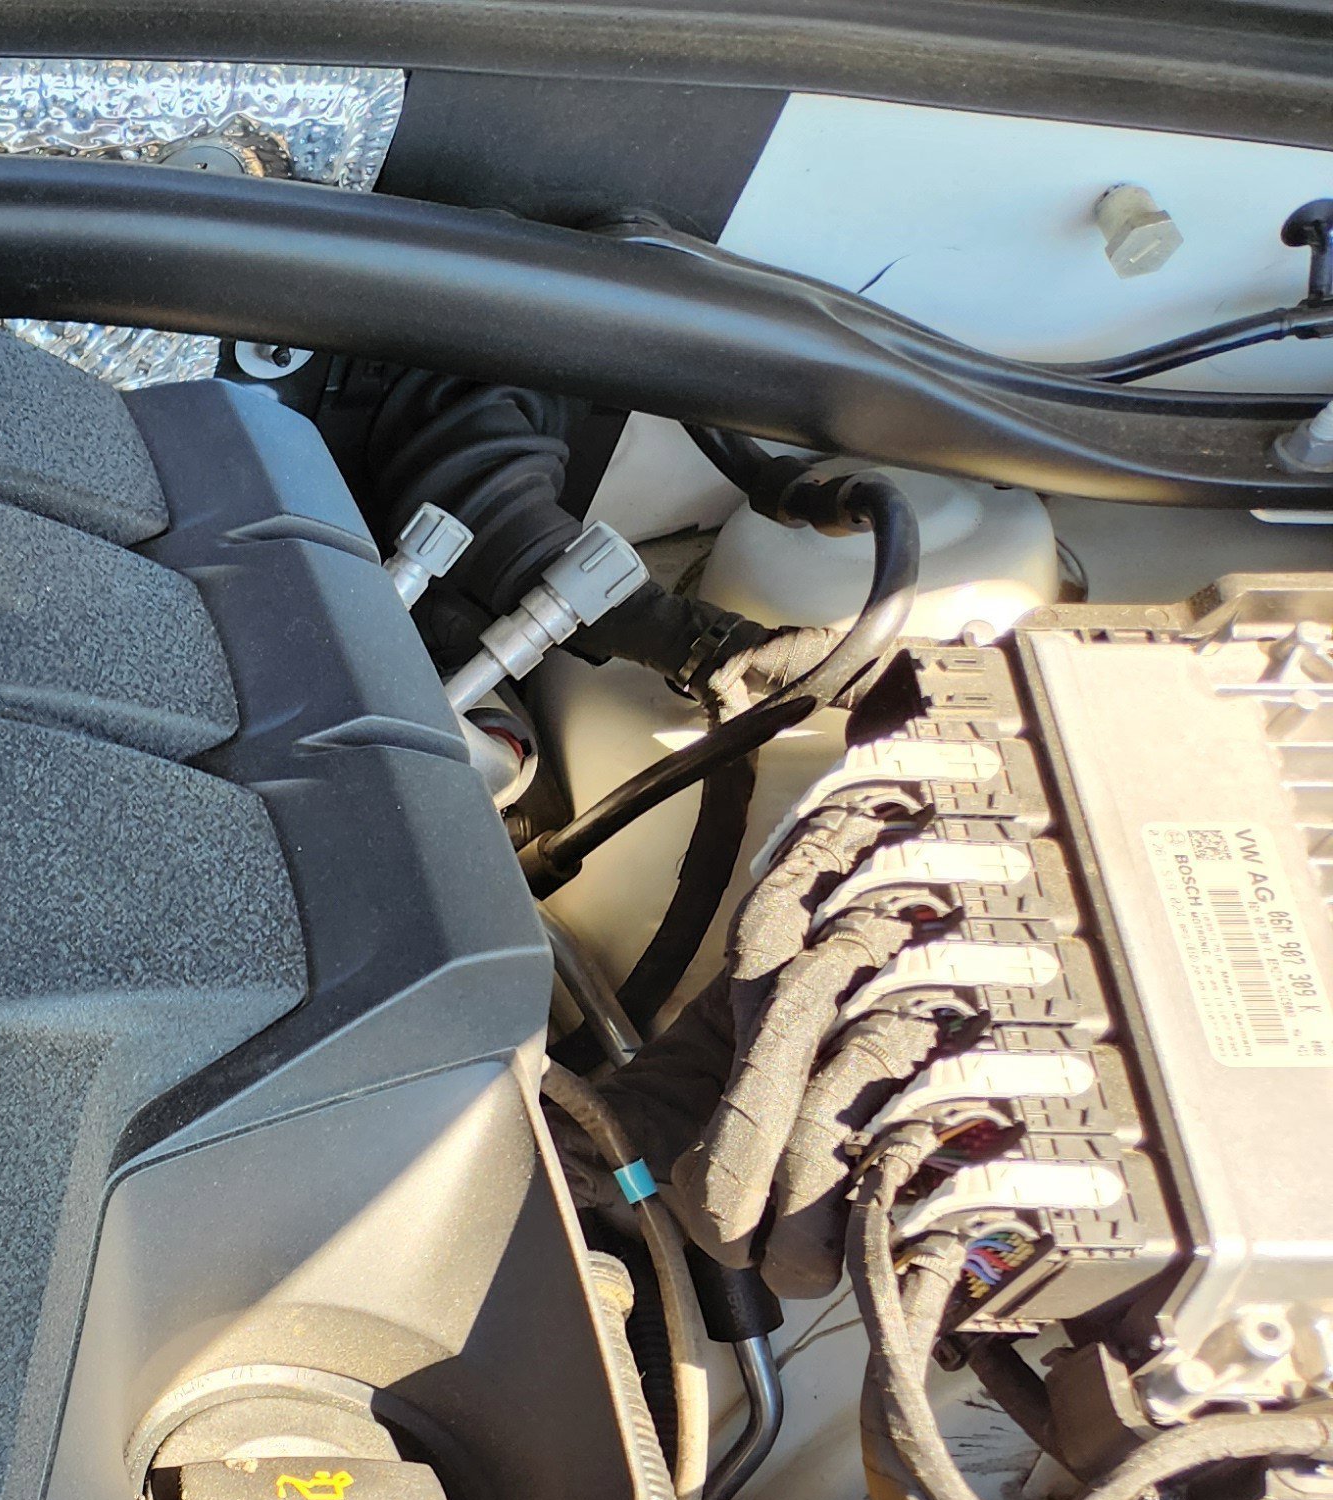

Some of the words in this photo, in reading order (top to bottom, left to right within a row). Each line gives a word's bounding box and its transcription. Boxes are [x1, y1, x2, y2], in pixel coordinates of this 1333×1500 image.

[1233, 828, 1263, 864] VW
[1173, 854, 1203, 906] BOSCH
[1247, 871, 1276, 902] AG
[1266, 911, 1295, 933] 06M
[1276, 942, 1306, 965] 907
[1287, 973, 1317, 996] 309
[1297, 1004, 1322, 1013] K
